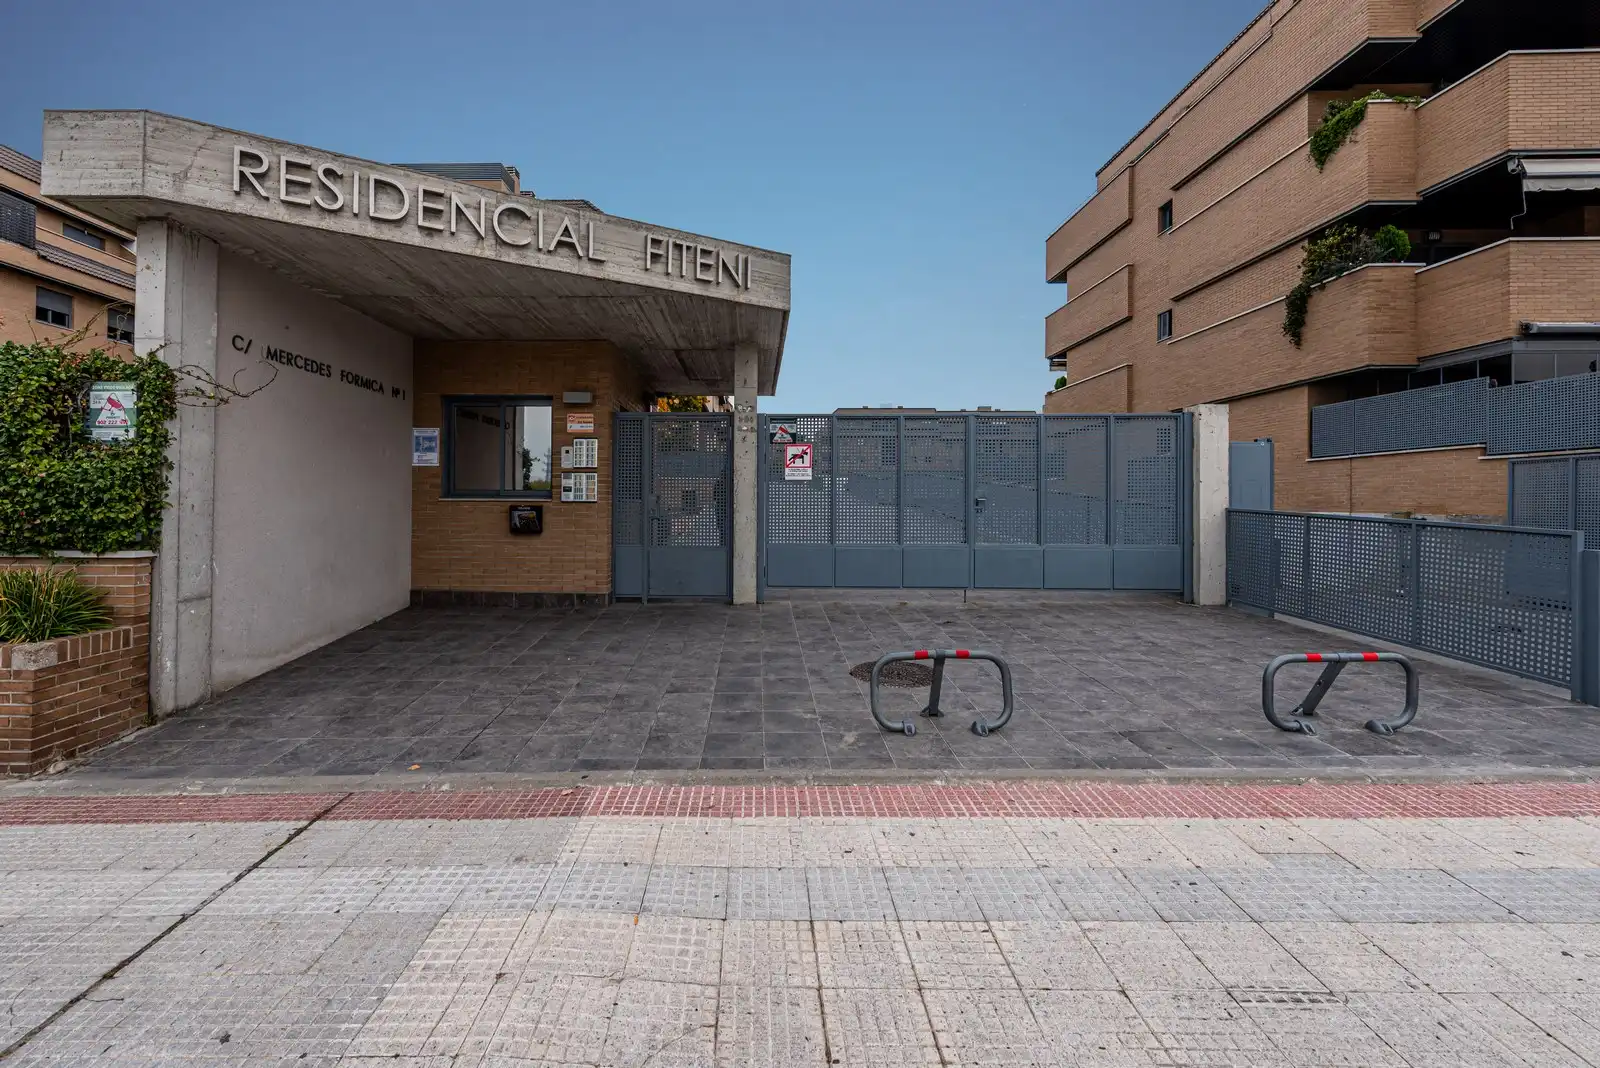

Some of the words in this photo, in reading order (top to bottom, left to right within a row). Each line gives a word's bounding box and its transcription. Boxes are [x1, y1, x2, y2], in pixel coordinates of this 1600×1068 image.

[233, 145, 606, 262] RESIDENCIAL
[644, 232, 751, 290] FITENI
[231, 334, 253, 354] C/
[266, 345, 332, 378] MERCEDES
[340, 369, 385, 395] FORMICA
